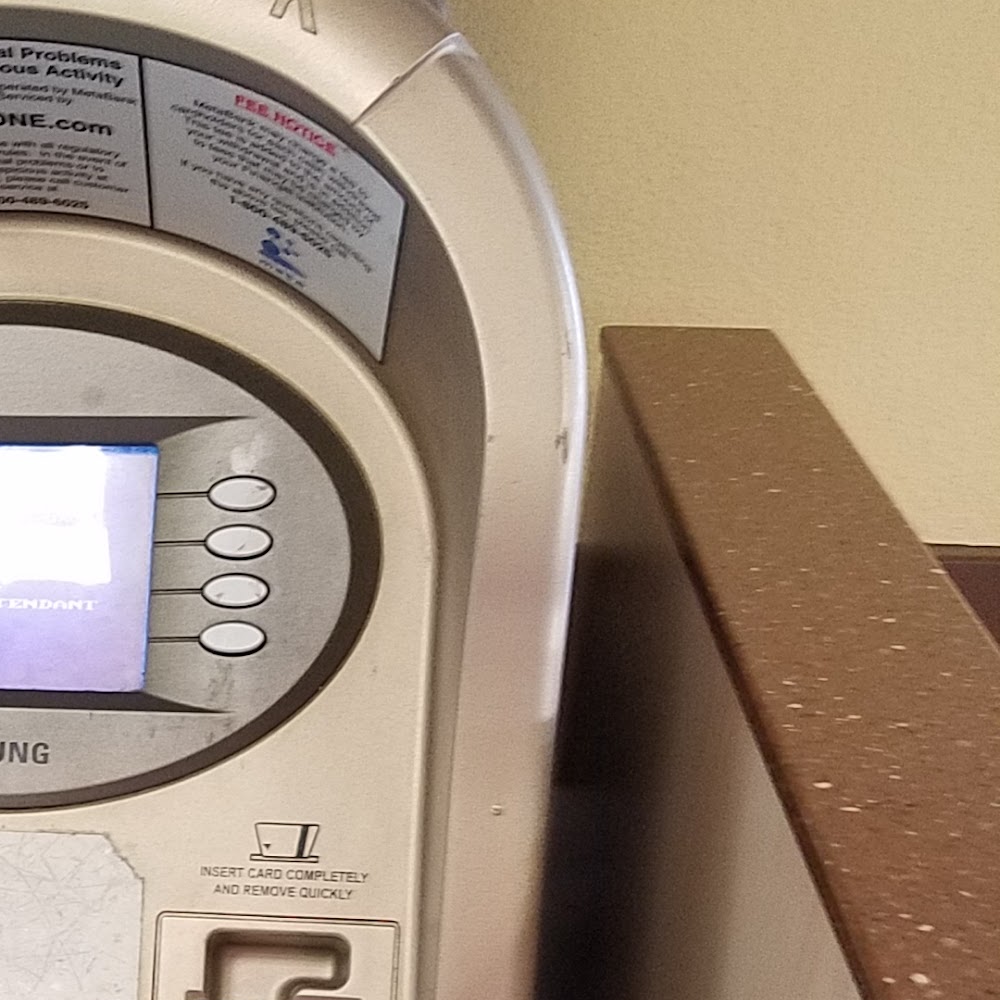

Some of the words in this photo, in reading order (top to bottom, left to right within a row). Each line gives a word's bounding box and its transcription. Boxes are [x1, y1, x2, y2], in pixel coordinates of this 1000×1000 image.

[21, 47, 122, 70] Problems
[46, 65, 123, 88] Activity
[200, 865, 244, 879] INSERT
[247, 867, 282, 880] CARD
[285, 869, 369, 883] COMPLETELY
[213, 883, 240, 895] AND
[243, 884, 296, 898] REMOVE
[299, 886, 353, 900] QUICKLY
